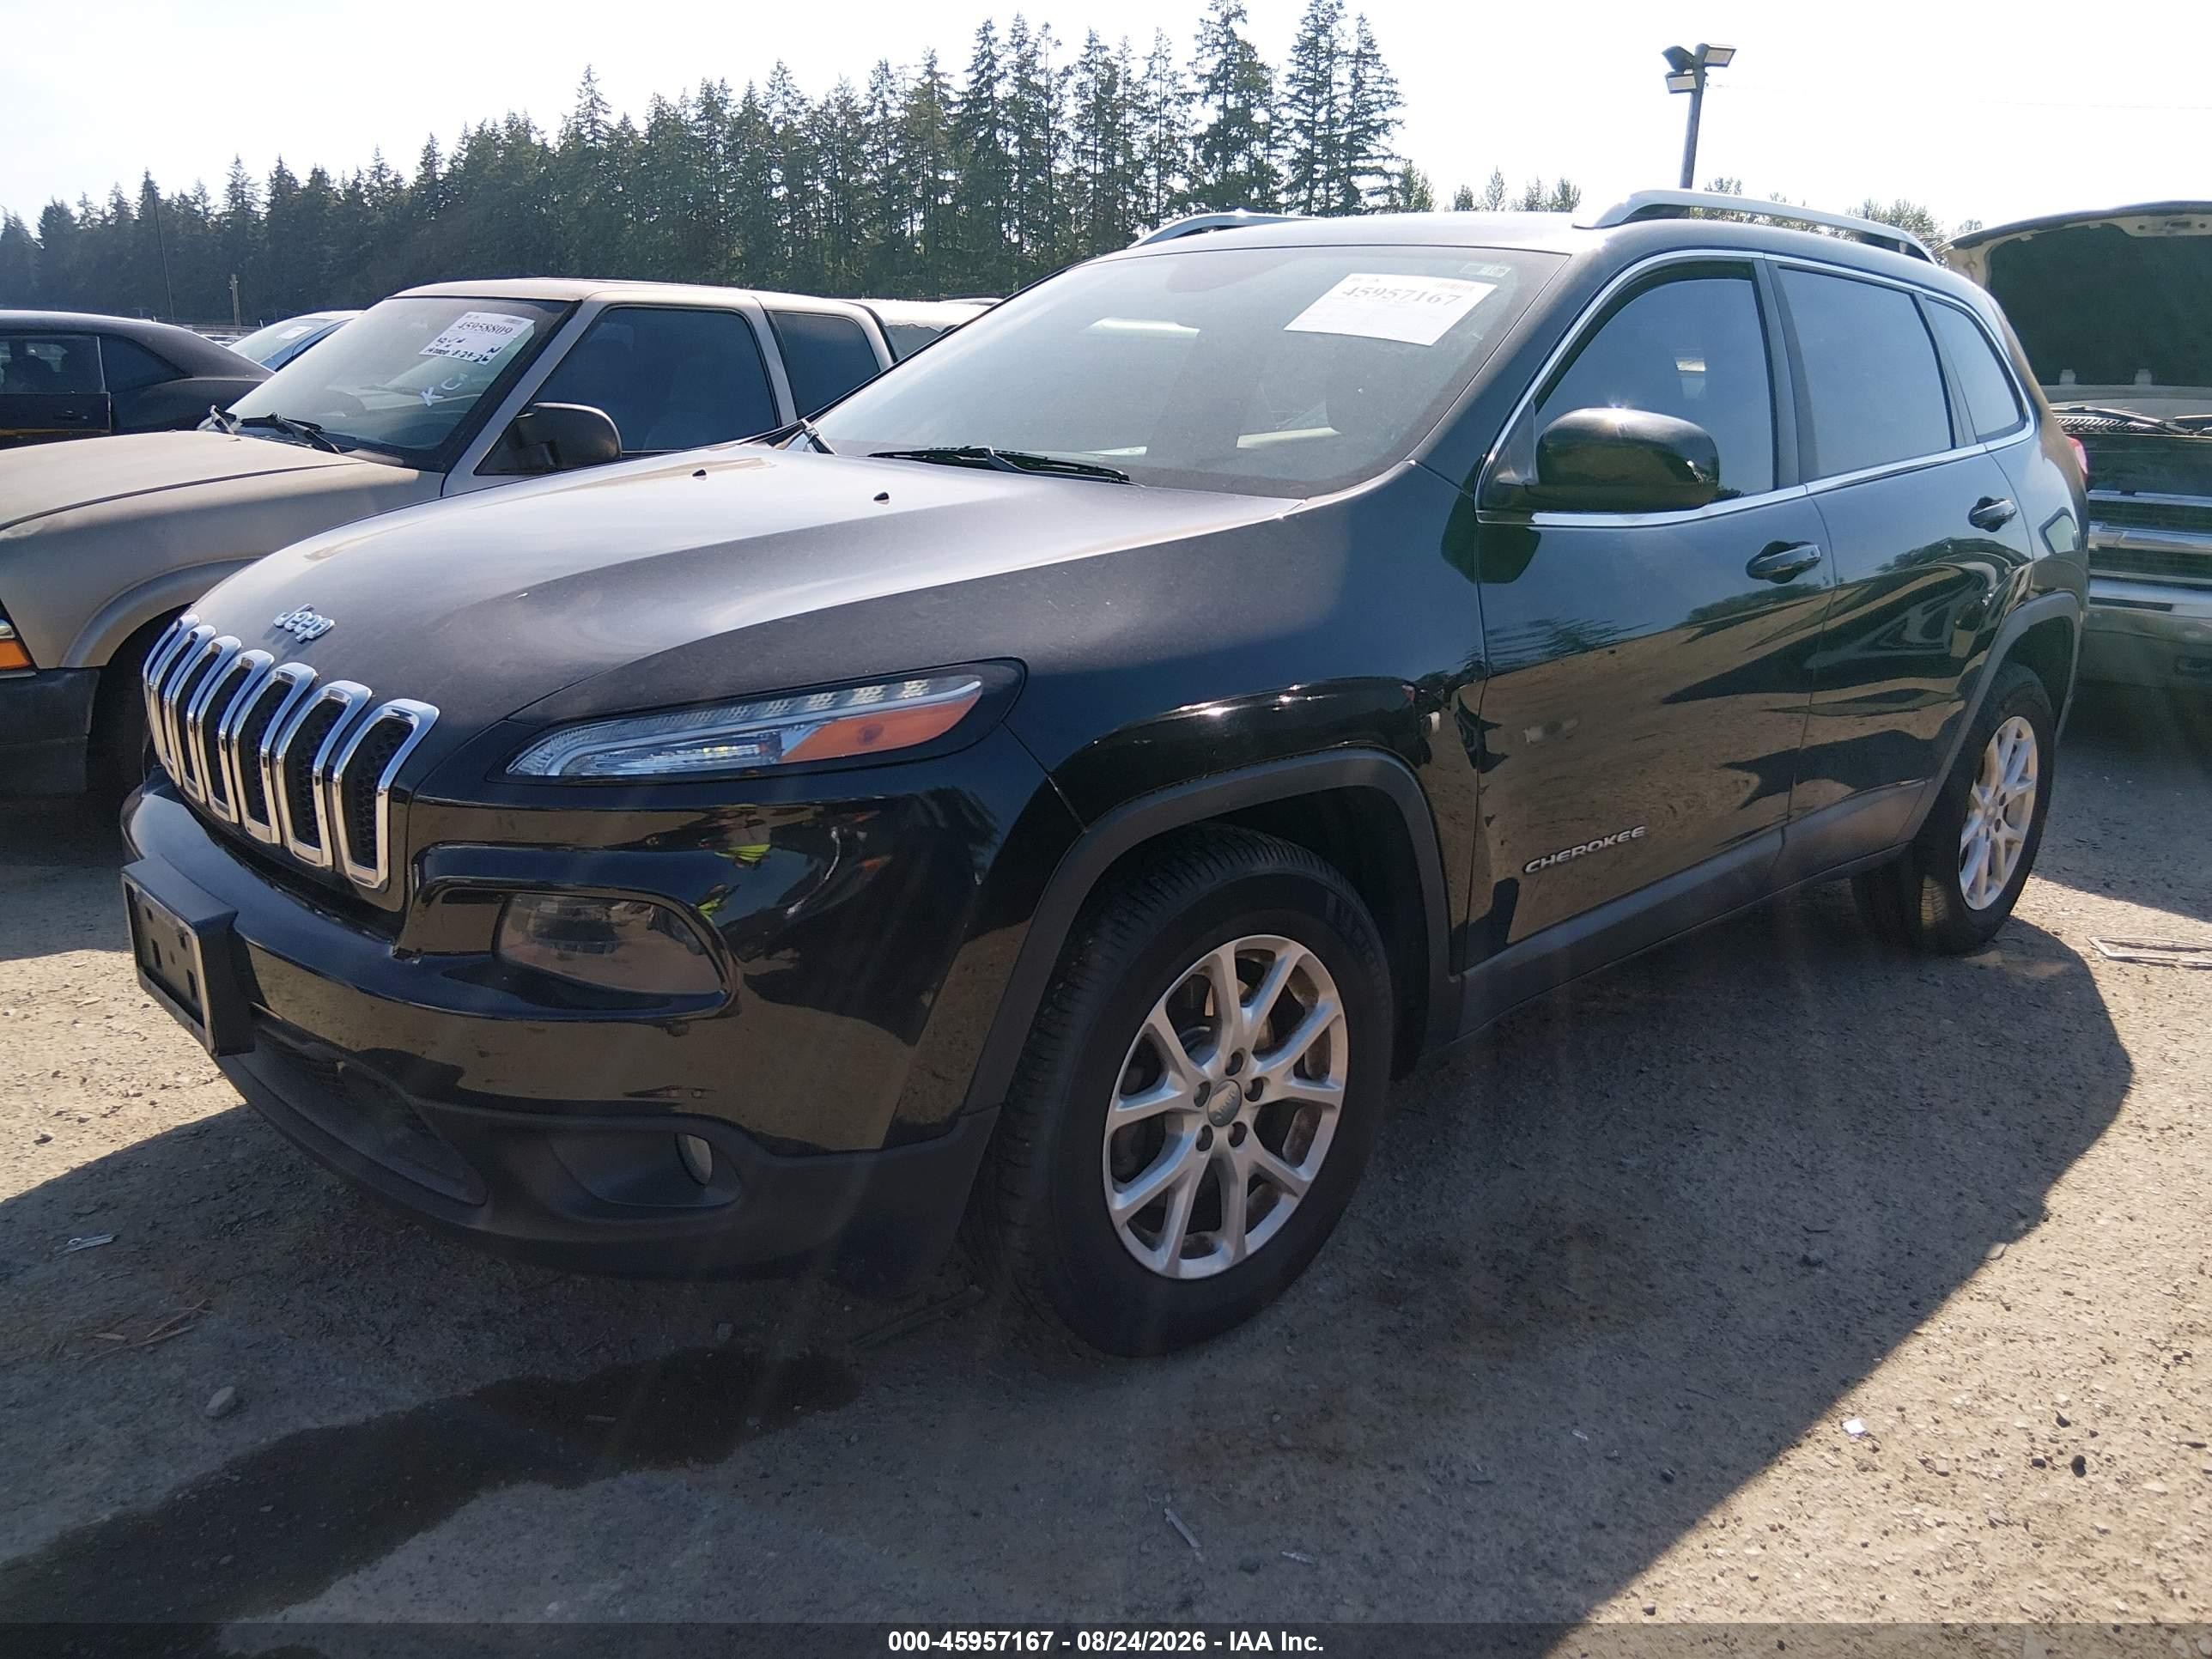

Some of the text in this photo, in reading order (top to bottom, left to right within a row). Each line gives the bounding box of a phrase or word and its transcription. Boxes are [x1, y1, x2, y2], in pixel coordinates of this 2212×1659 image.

[1342, 286, 1462, 306] 45957167
[458, 321, 514, 336] 45958809
[274, 603, 336, 644] Jeep
[1524, 825, 1647, 873] CHEROKEE
